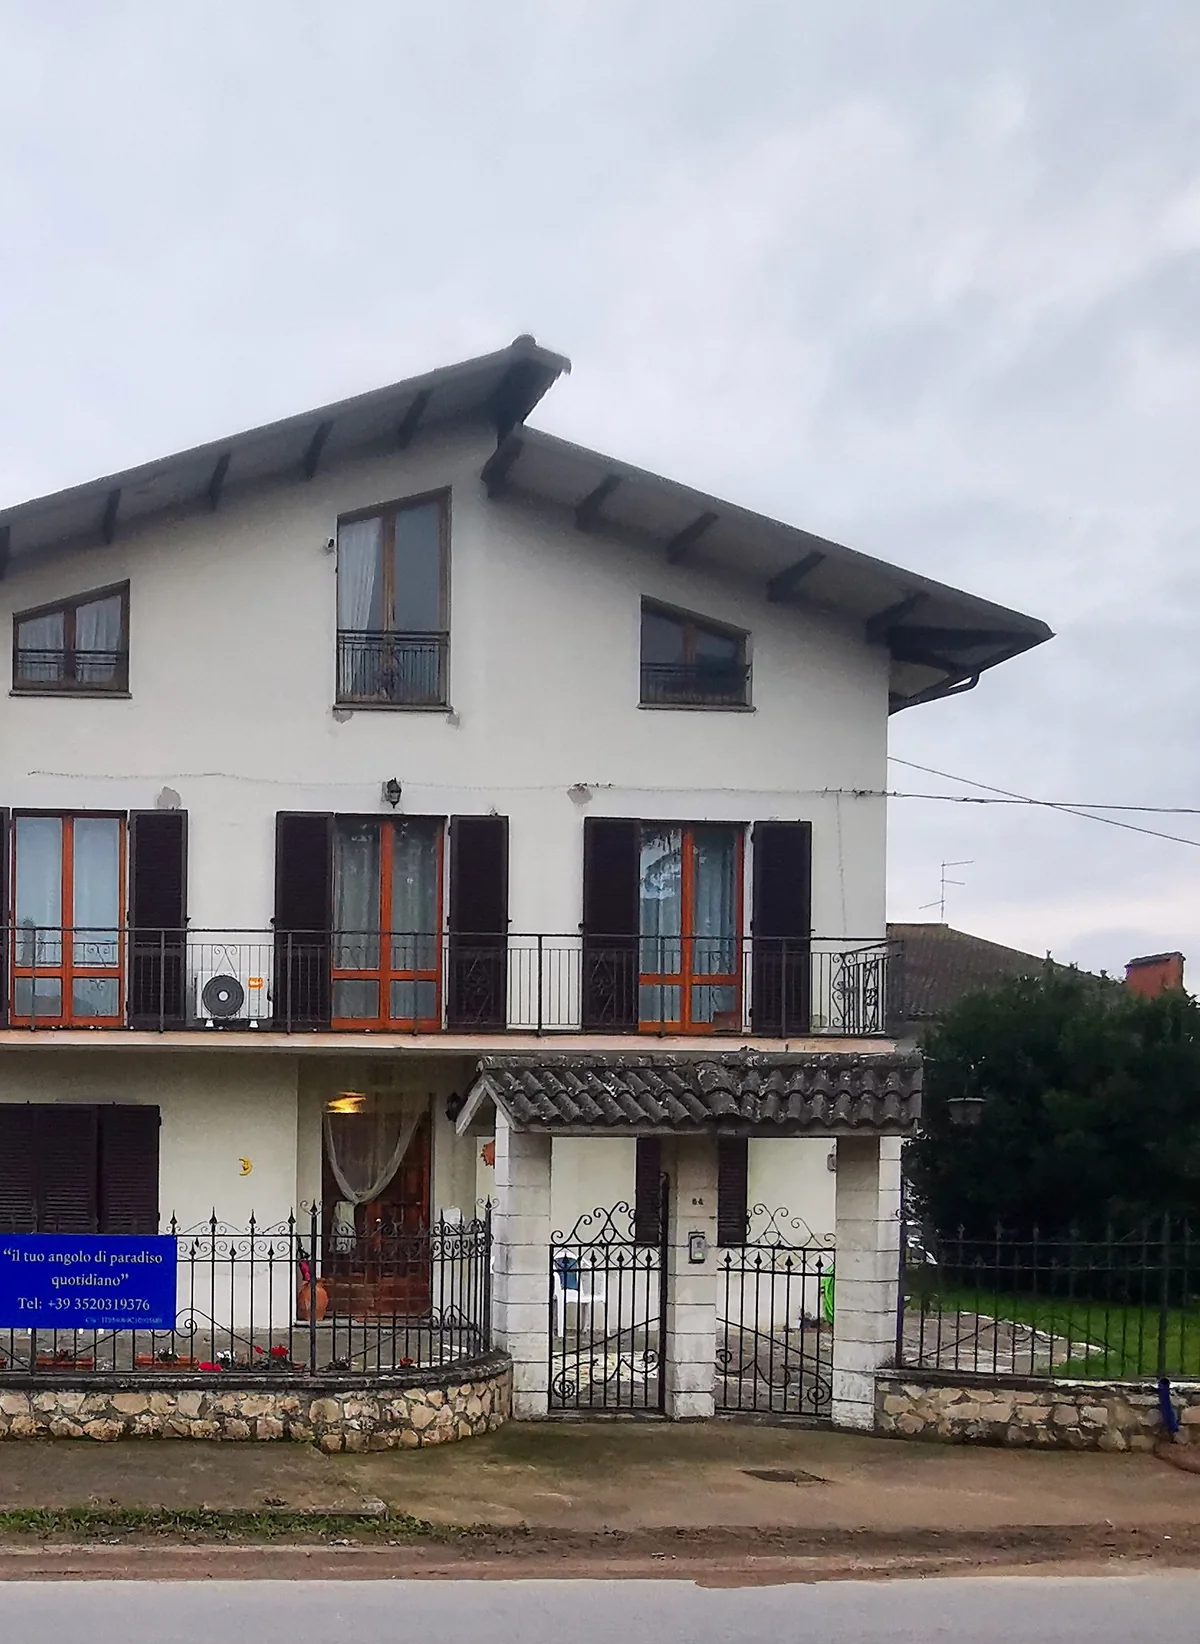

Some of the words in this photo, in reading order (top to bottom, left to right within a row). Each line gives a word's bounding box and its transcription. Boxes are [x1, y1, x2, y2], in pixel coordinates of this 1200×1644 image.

[24, 1252, 45, 1262] tuo
[48, 1250, 91, 1265] angolo
[94, 1250, 106, 1263] di
[110, 1251, 163, 1266] paradiso
[17, 1297, 42, 1310] Tel:
[48, 1298, 71, 1310] +39
[74, 1298, 150, 1311] 3520319376
